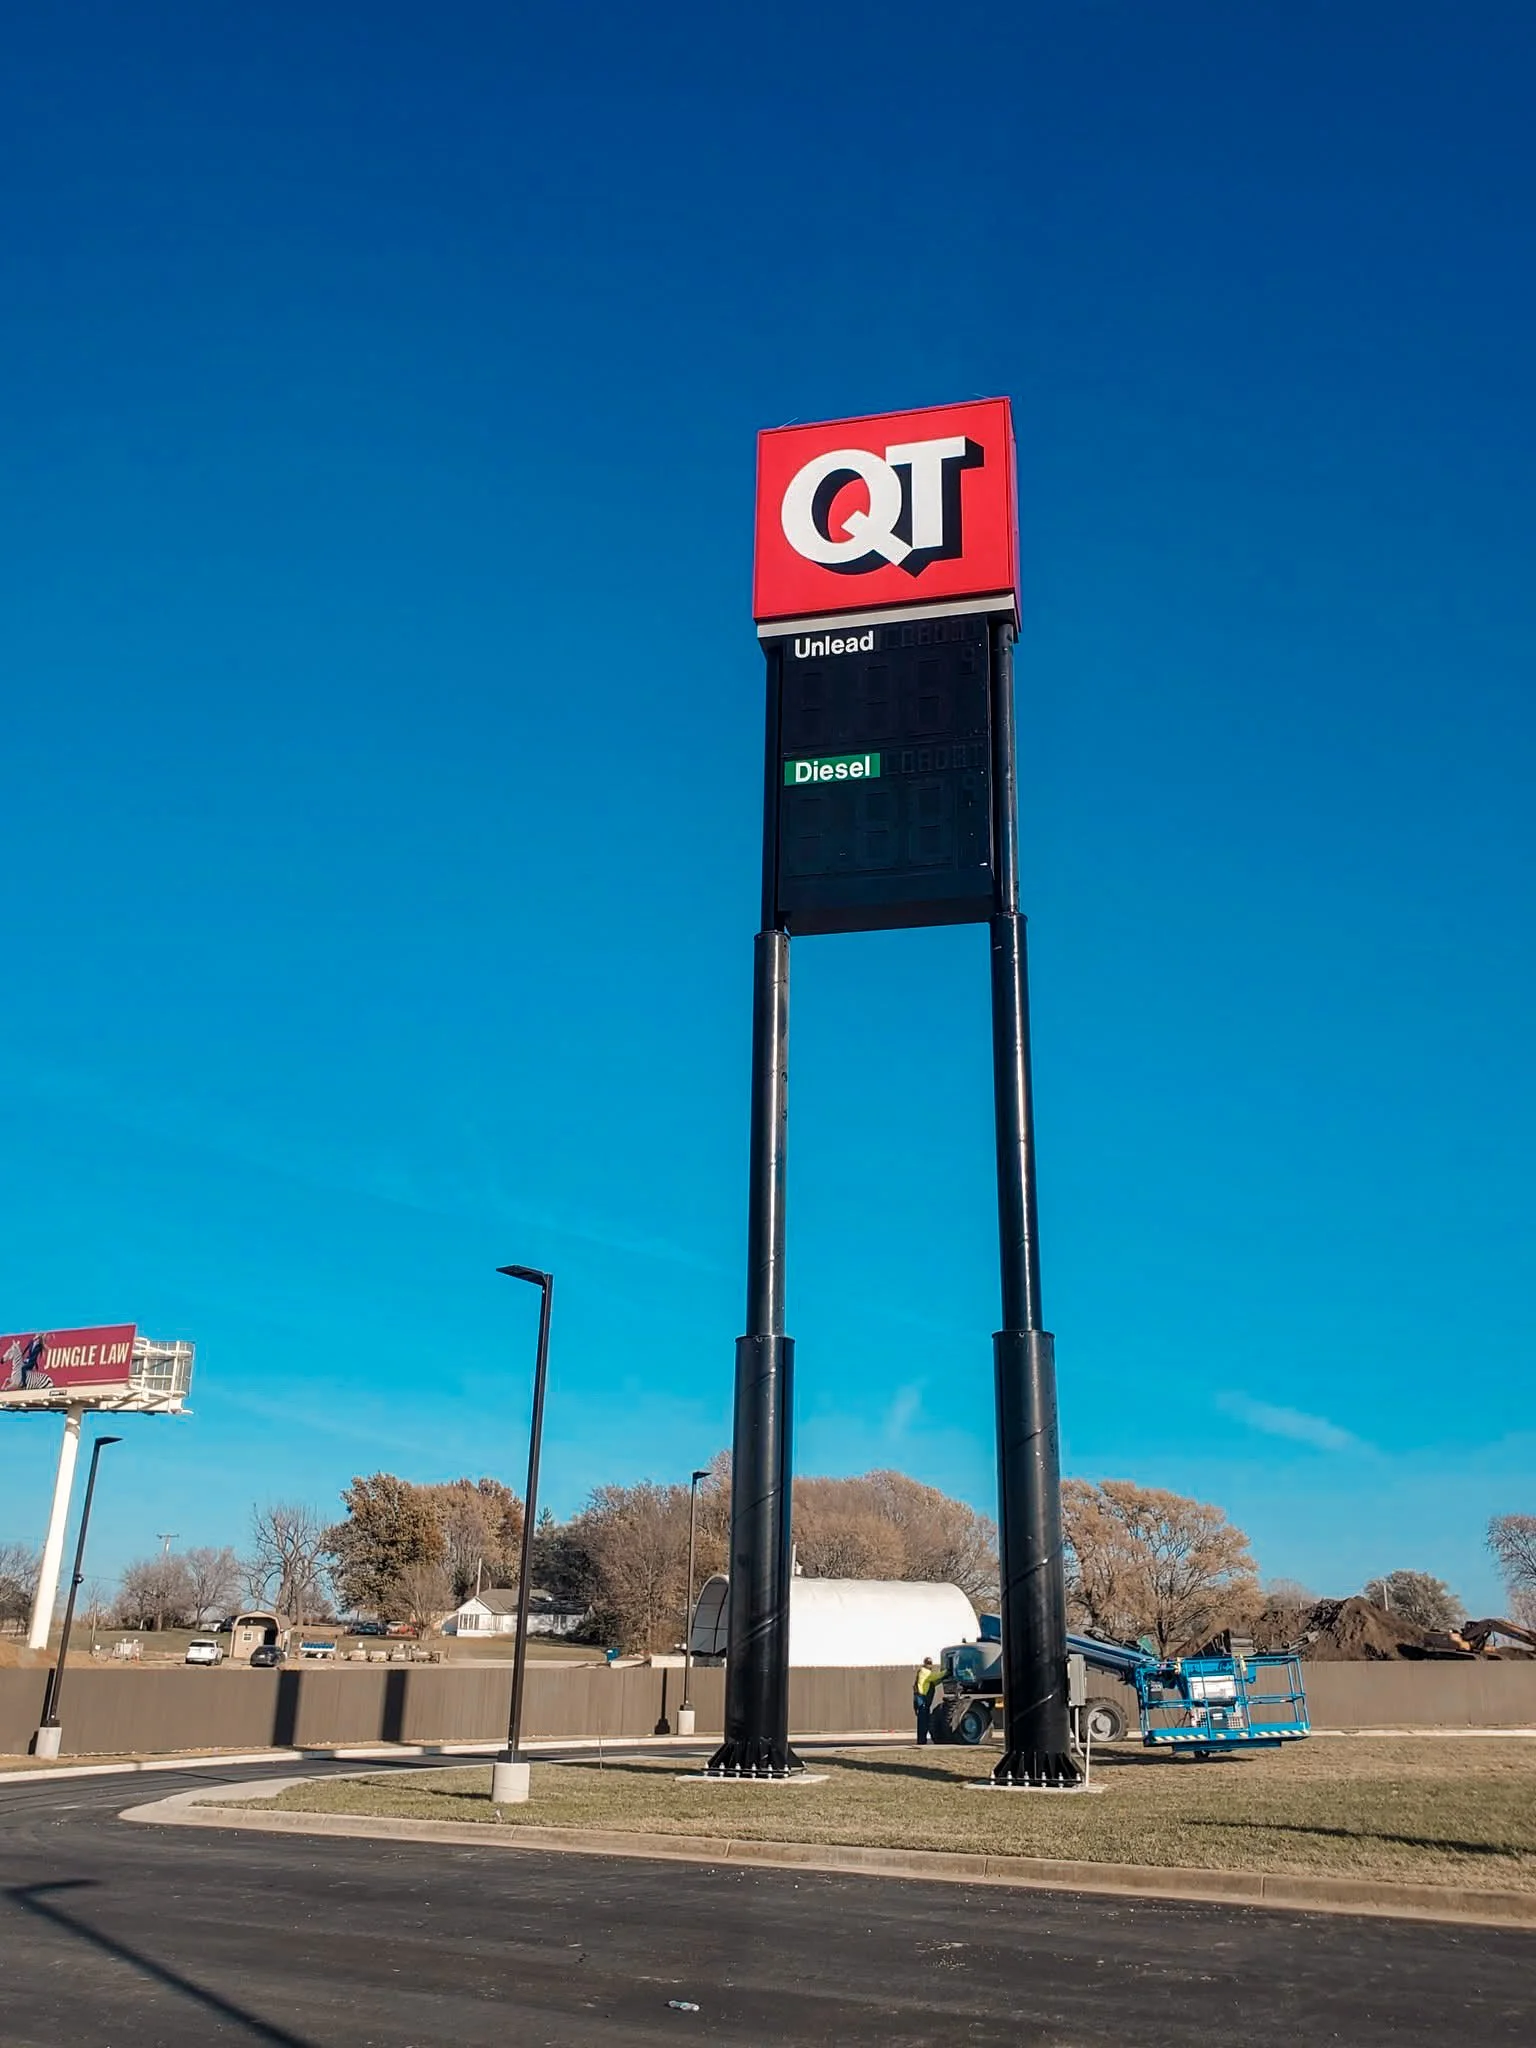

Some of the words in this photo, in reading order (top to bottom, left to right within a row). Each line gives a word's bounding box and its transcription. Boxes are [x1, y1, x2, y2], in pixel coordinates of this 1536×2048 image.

[781, 436, 978, 573] QT
[794, 630, 875, 659] Unlead
[795, 755, 871, 783] Diesel
[44, 1345, 96, 1370] JUNGLE
[99, 1342, 130, 1365] LAW
